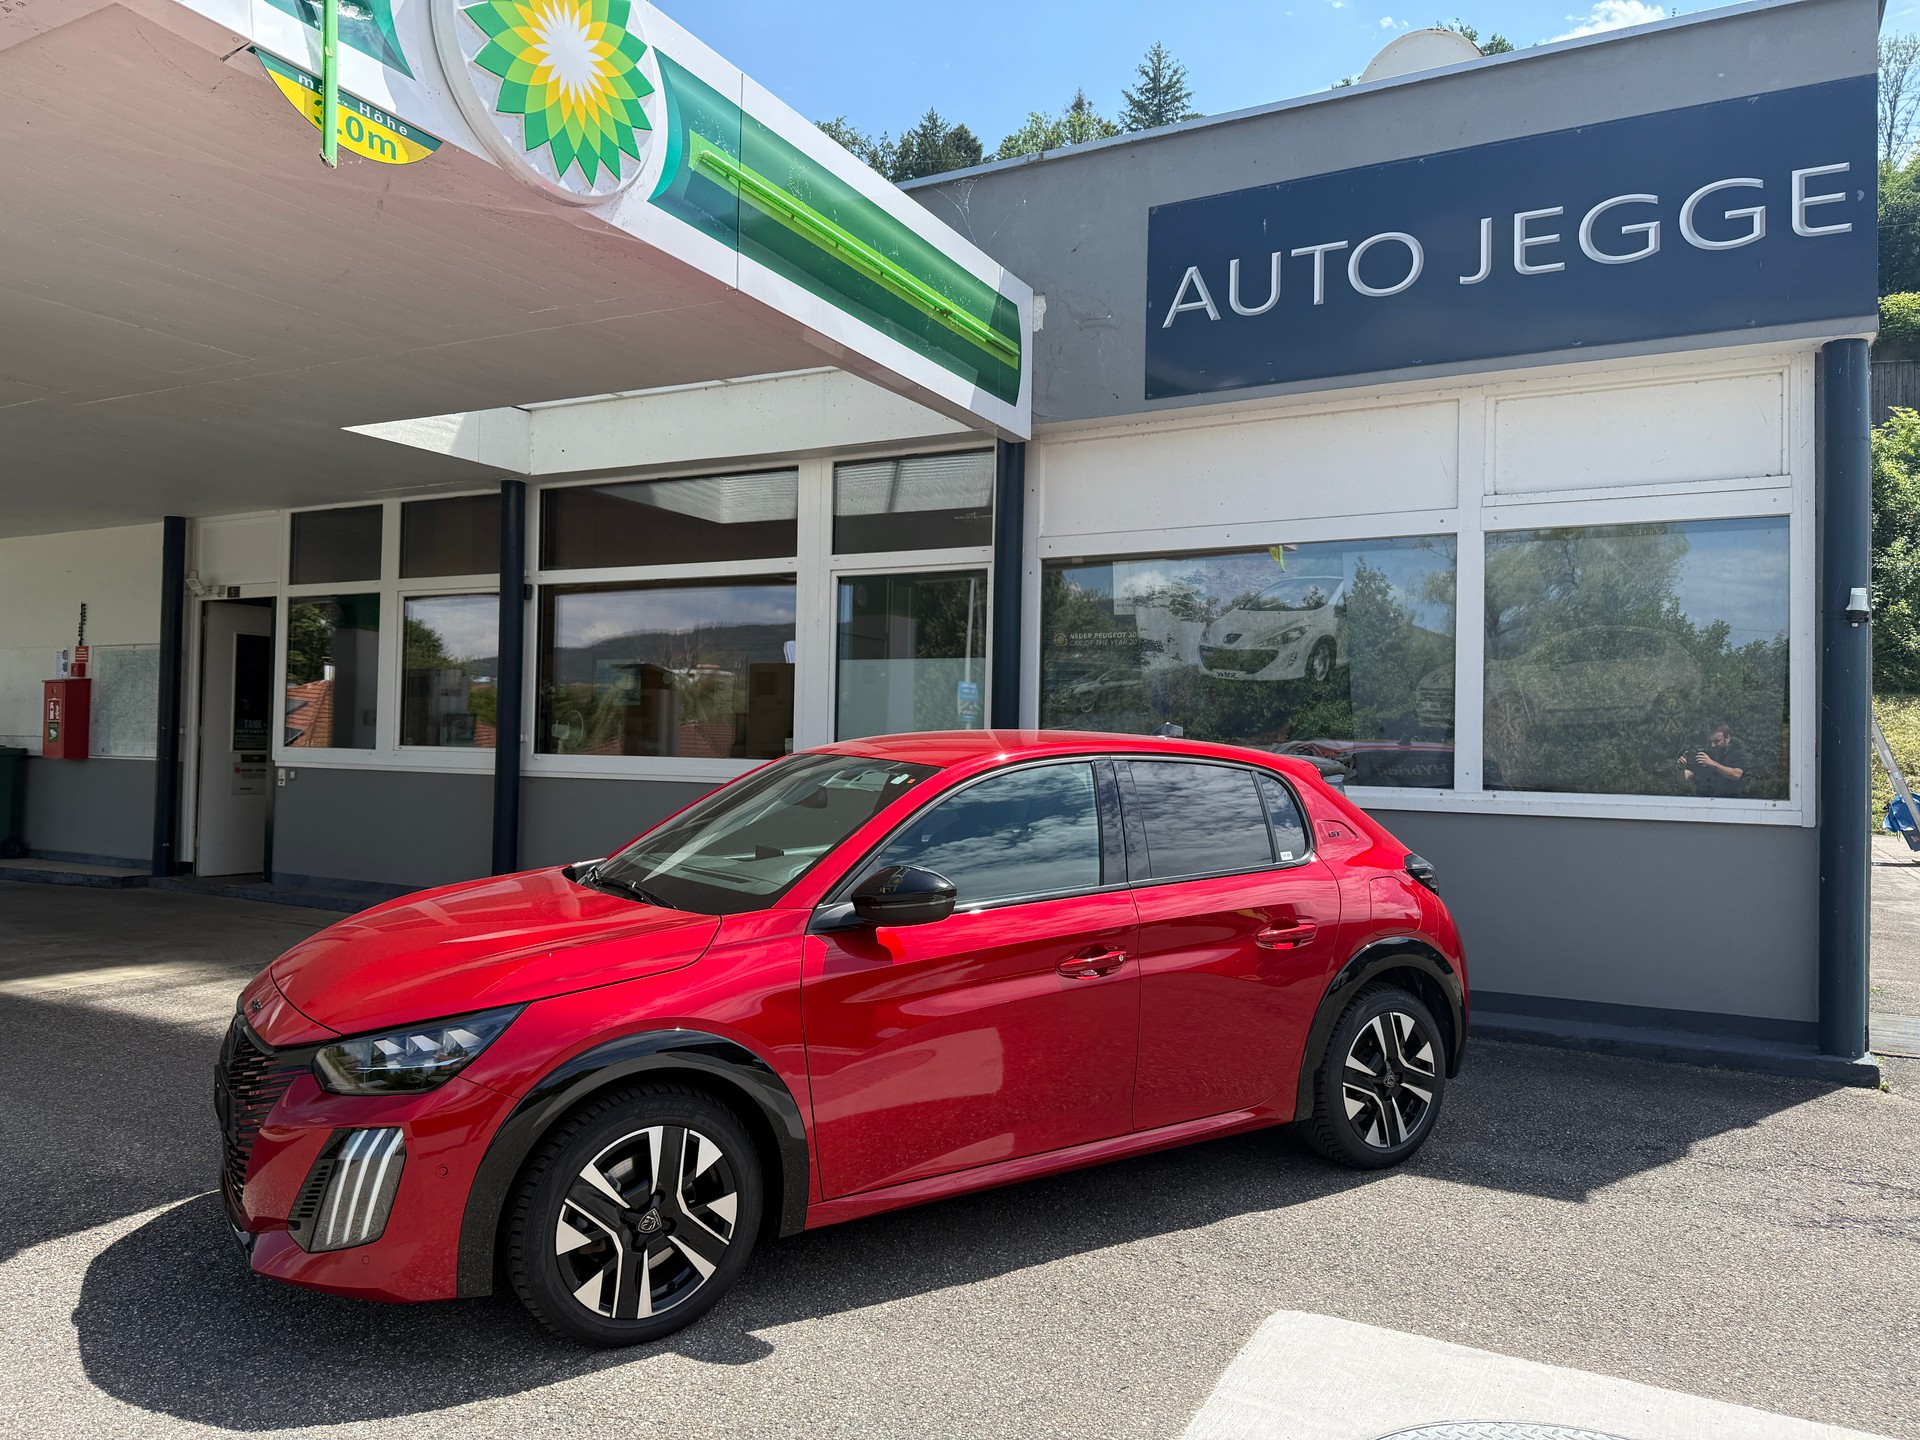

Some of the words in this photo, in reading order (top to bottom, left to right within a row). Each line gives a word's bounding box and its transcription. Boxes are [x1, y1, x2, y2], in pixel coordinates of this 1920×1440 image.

[359, 101, 408, 136] Höhe
[1161, 230, 1425, 329] AUTO
[1458, 161, 1853, 287] JEGGE
[1069, 632, 1093, 640] NEUER
[1093, 631, 1127, 639] PEUGEOT
[1328, 830, 1342, 838] GT
